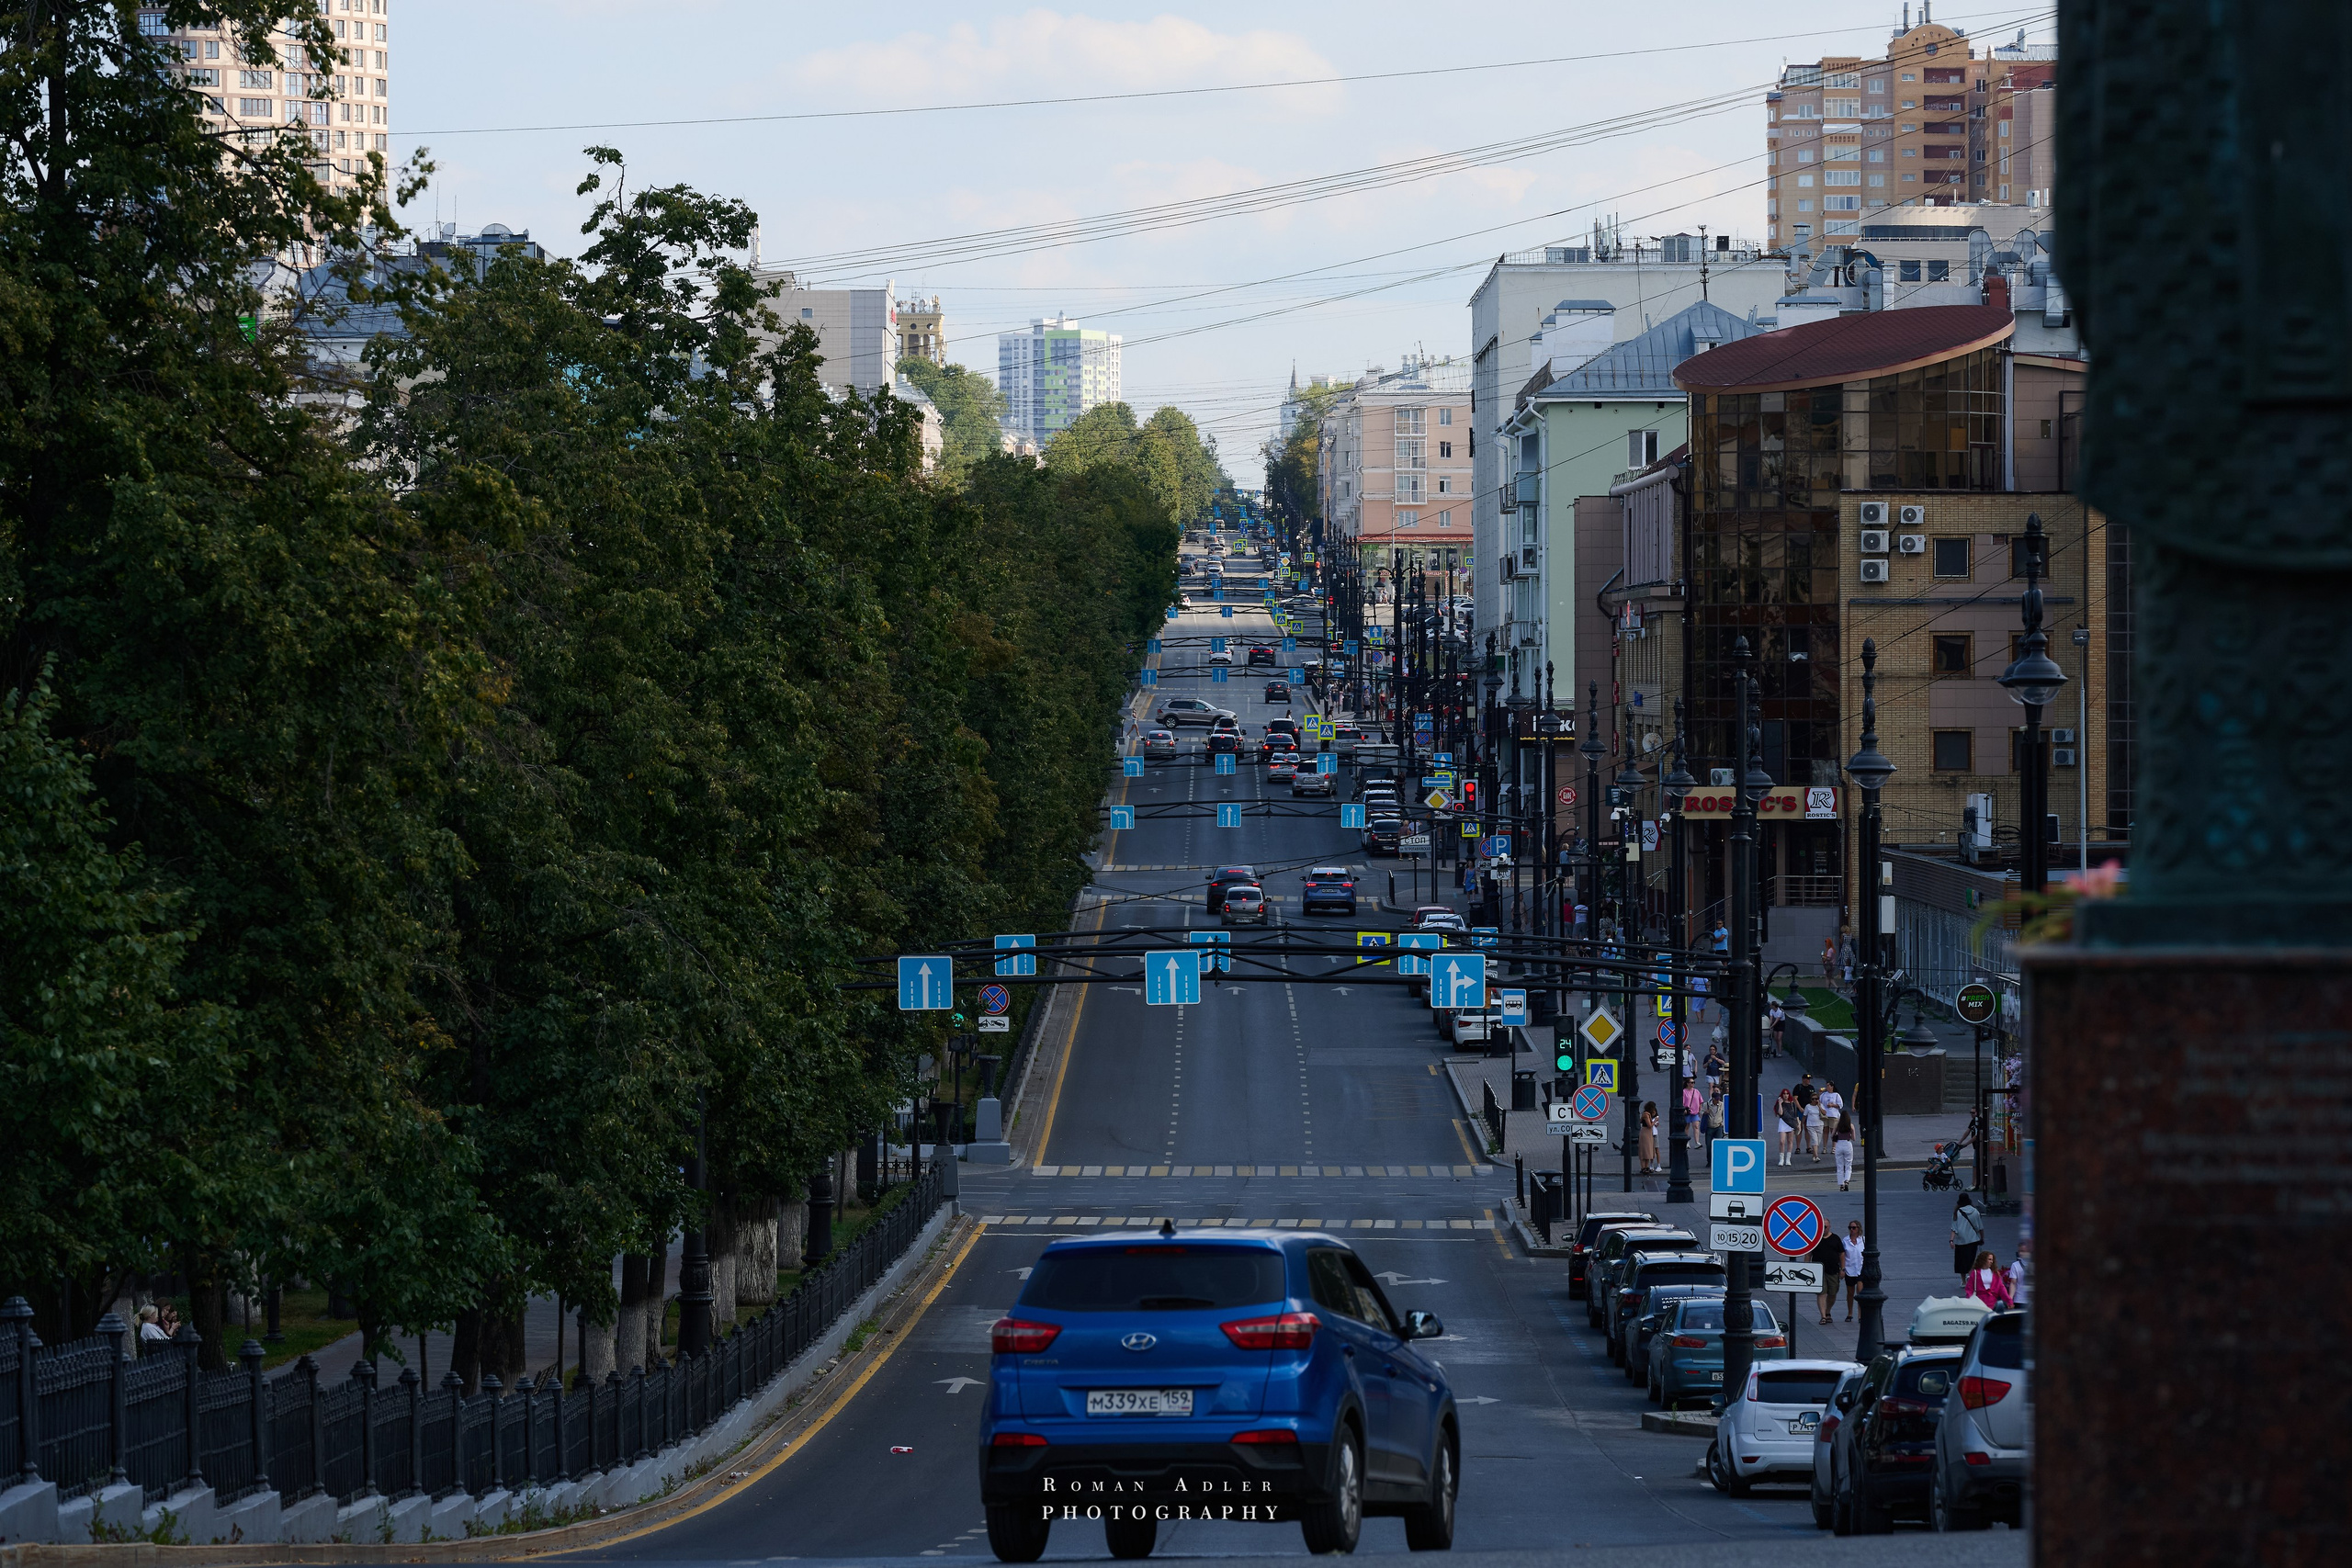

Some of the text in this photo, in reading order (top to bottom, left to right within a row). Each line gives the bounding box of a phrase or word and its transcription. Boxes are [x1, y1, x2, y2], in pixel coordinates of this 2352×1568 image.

[1559, 1039, 1572, 1049] 24
[1717, 1233, 1758, 1245] 10 15 20
[1163, 1391, 1188, 1405] 159
